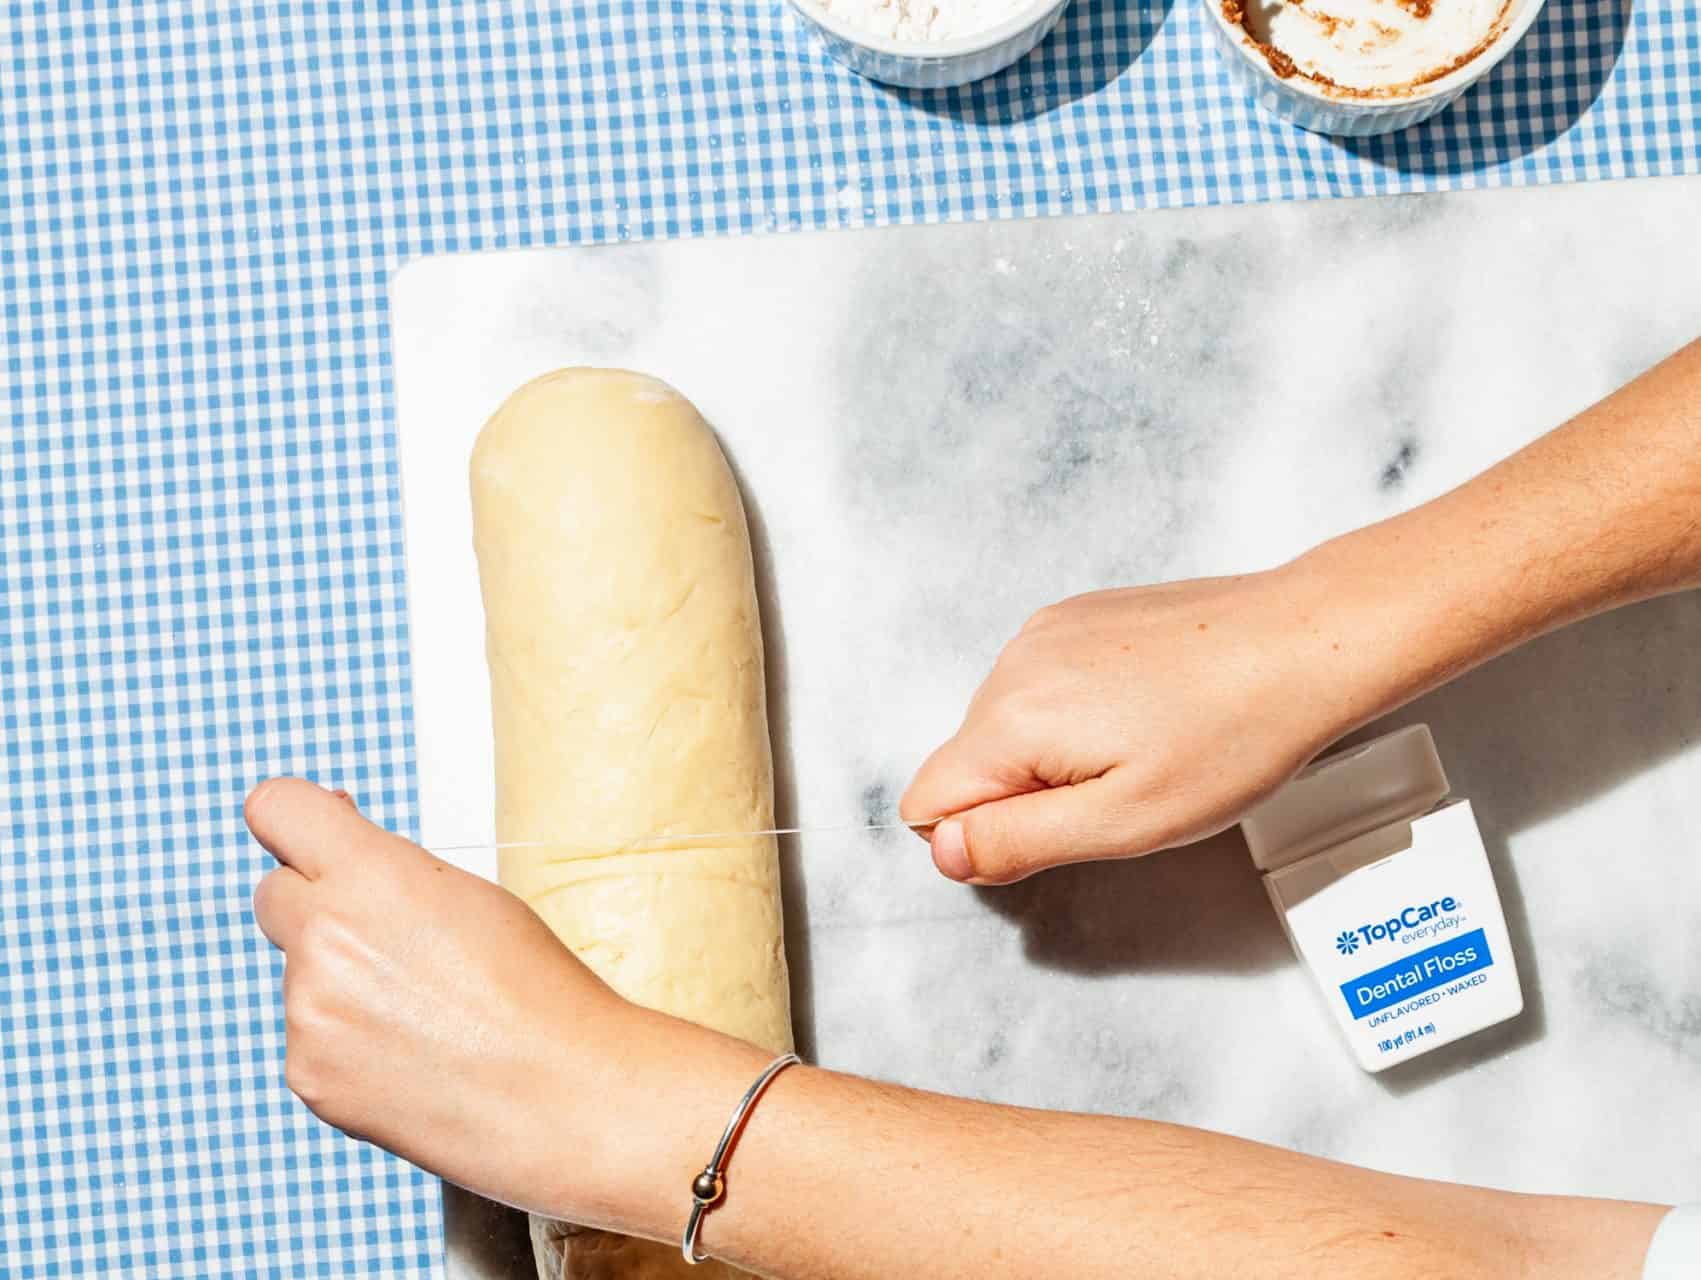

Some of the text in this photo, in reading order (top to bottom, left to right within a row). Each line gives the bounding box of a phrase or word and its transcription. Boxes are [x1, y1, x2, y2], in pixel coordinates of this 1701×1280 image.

[1357, 897, 1457, 945] TopCare
[1401, 914, 1461, 944] everyday
[1356, 946, 1478, 1006] Dental Floss
[1368, 973, 1488, 1028] UNFLAVORED WAXED
